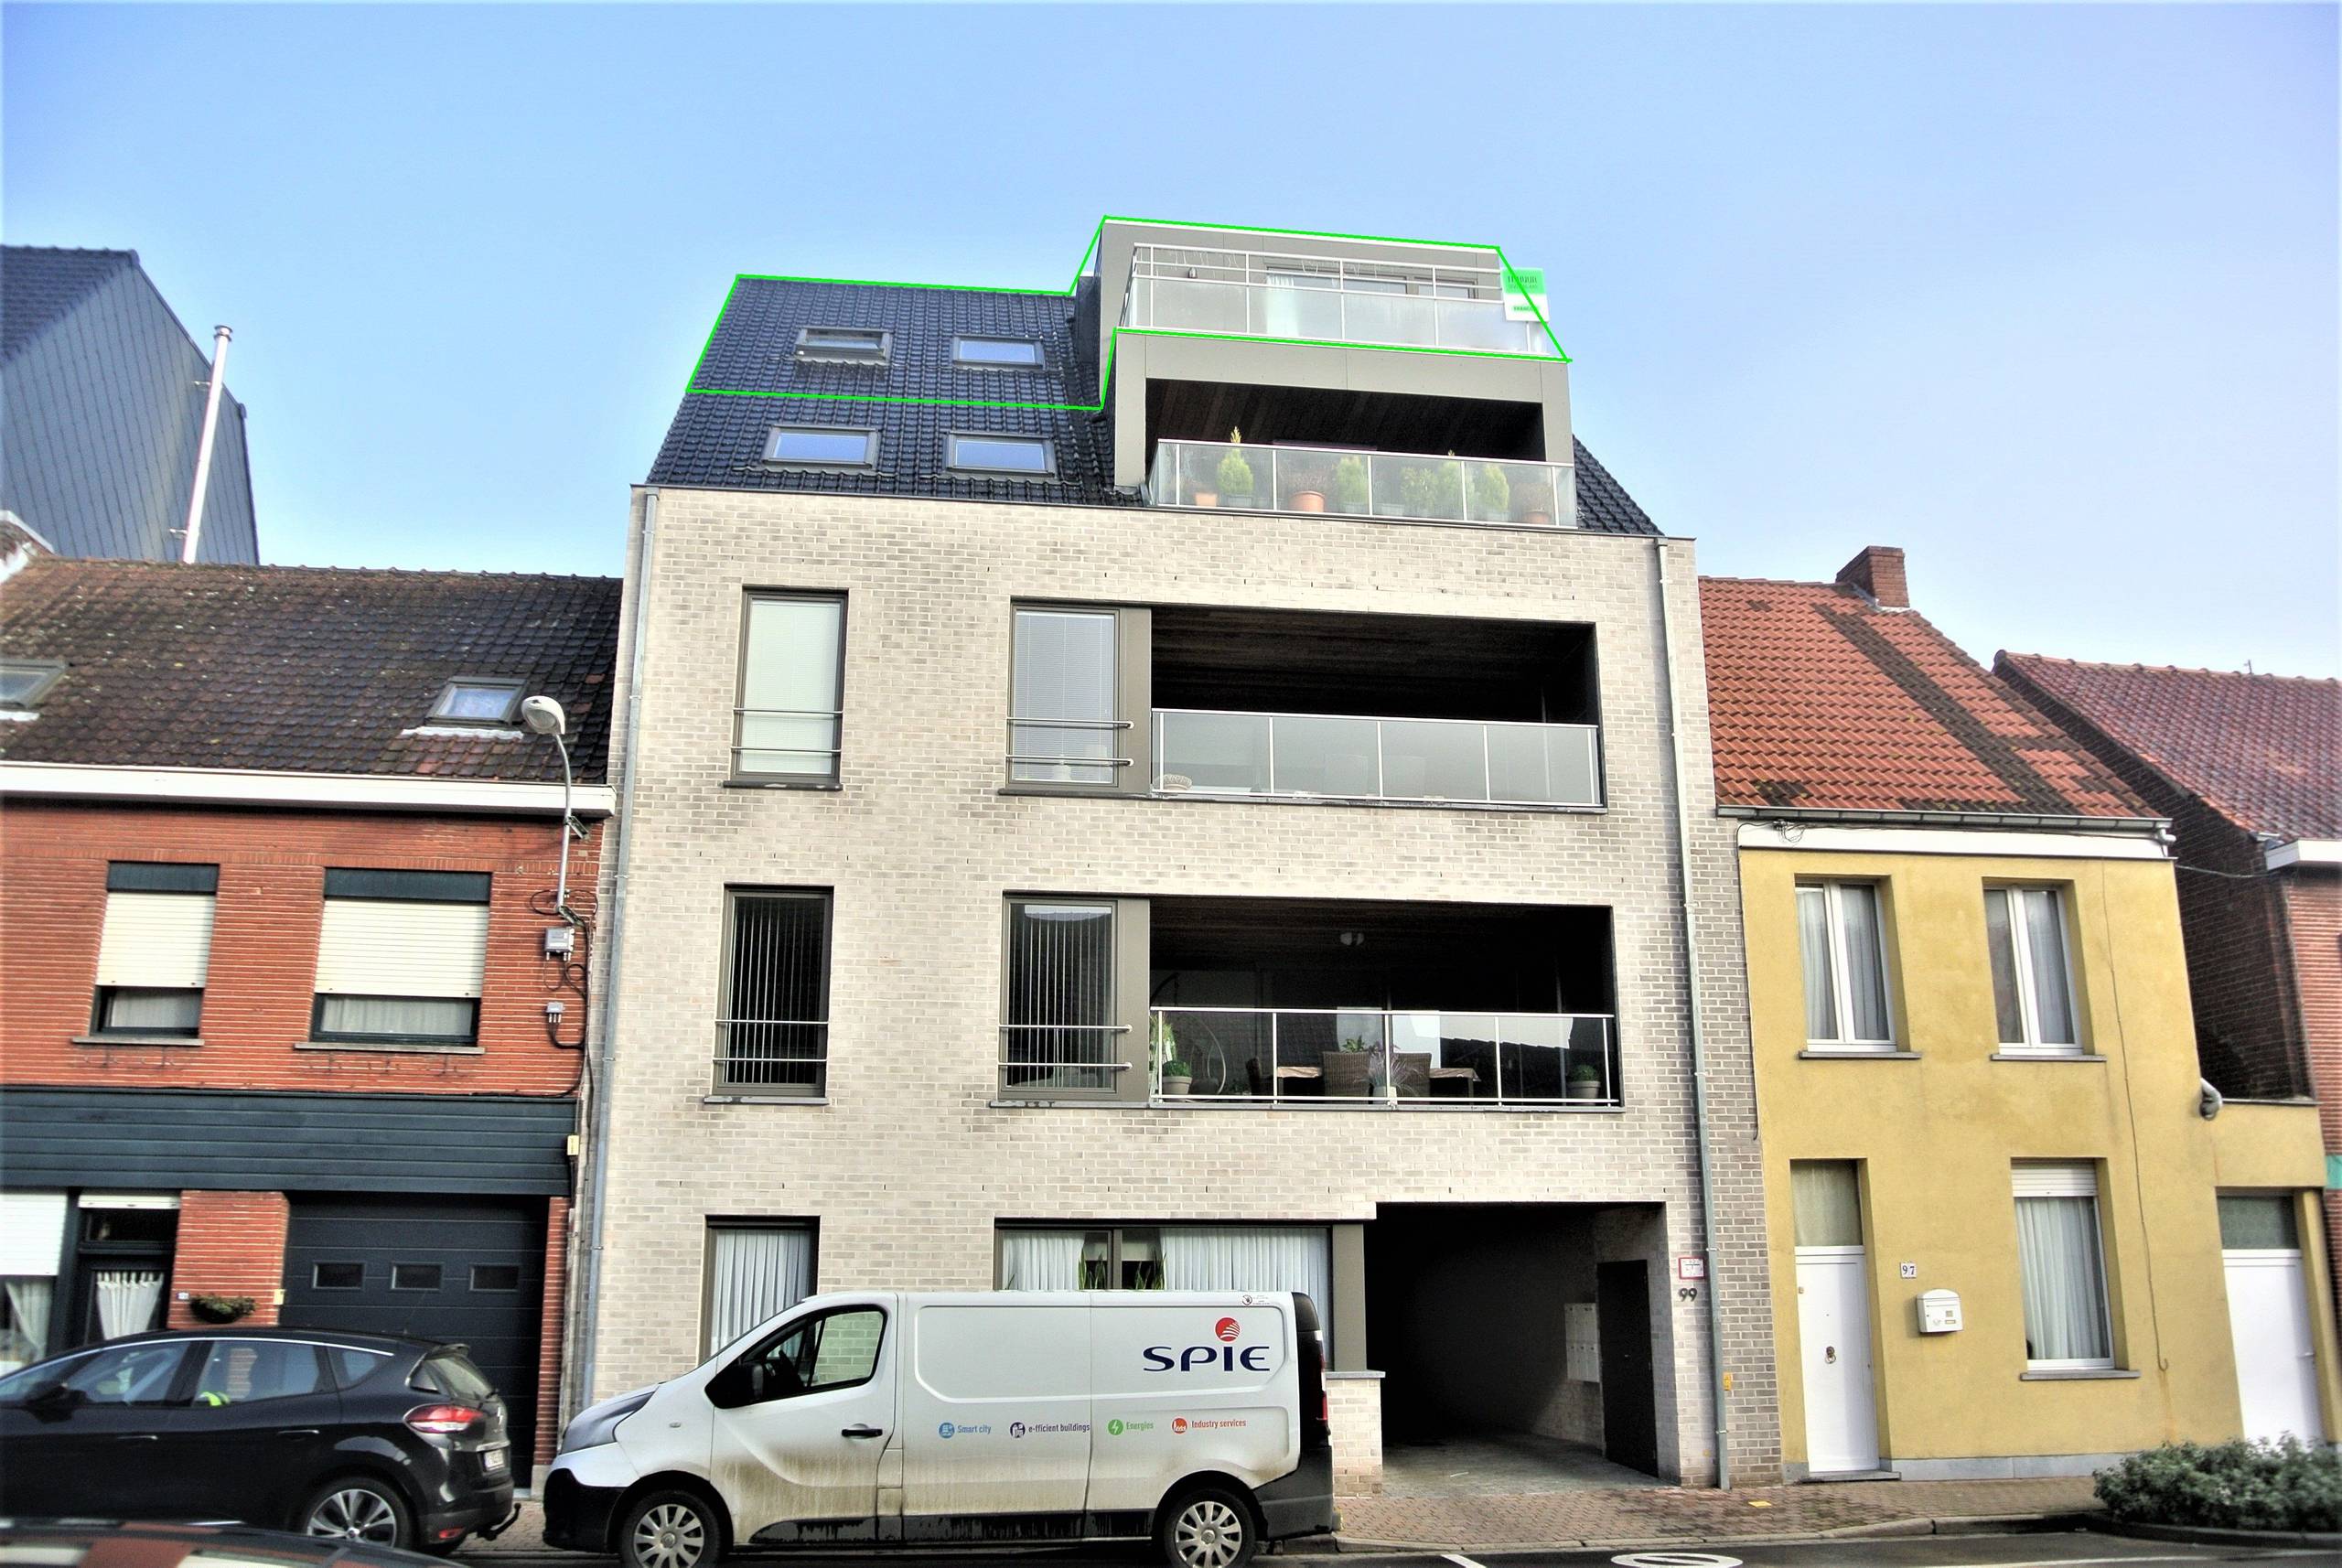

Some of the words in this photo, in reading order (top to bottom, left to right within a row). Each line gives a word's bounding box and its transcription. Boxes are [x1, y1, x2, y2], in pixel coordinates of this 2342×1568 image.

[1902, 1264, 1915, 1275] 97
[1678, 1287, 1698, 1302] 99
[1143, 1346, 1270, 1372] SPIE
[957, 1424, 978, 1434] Smart
[978, 1424, 992, 1435] city
[1060, 1423, 1090, 1434] buildings
[1126, 1421, 1154, 1432] Energies
[1191, 1420, 1219, 1429] Industry
[1219, 1419, 1247, 1428] services
